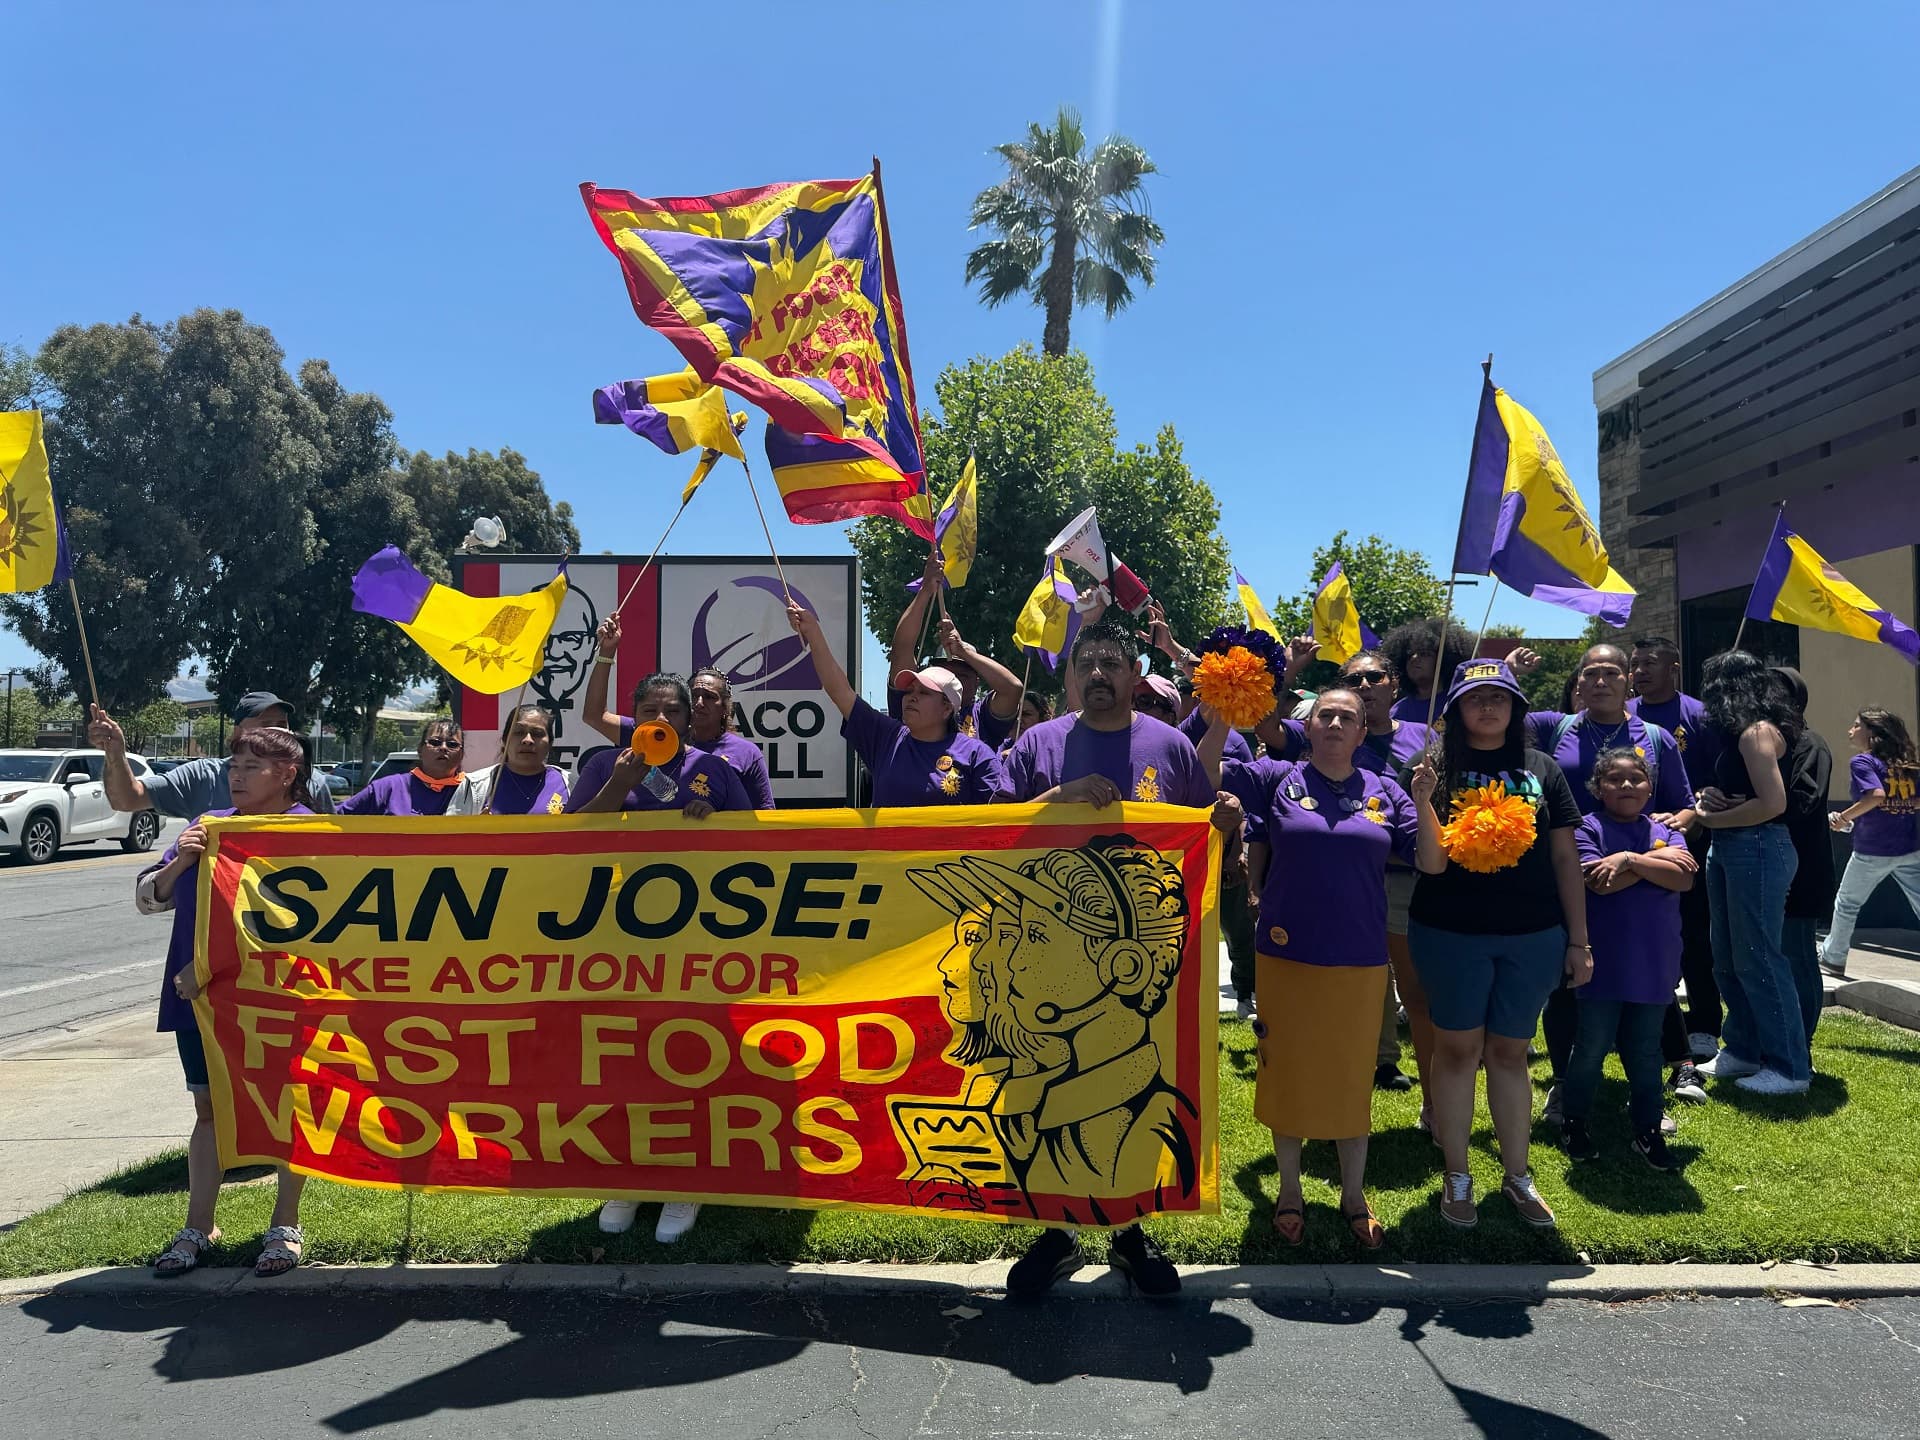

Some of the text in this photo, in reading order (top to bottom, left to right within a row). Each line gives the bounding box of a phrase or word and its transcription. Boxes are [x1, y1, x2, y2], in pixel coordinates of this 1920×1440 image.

[771, 264, 854, 334] FOOD
[732, 700, 825, 738] ACO
[756, 742, 823, 778] LL
[242, 861, 883, 943] SAN JOSE:
[249, 951, 799, 995] TAKE ACTION FOR
[237, 1003, 916, 1088] FAST FOOD
[242, 1077, 863, 1174] WORKERS
